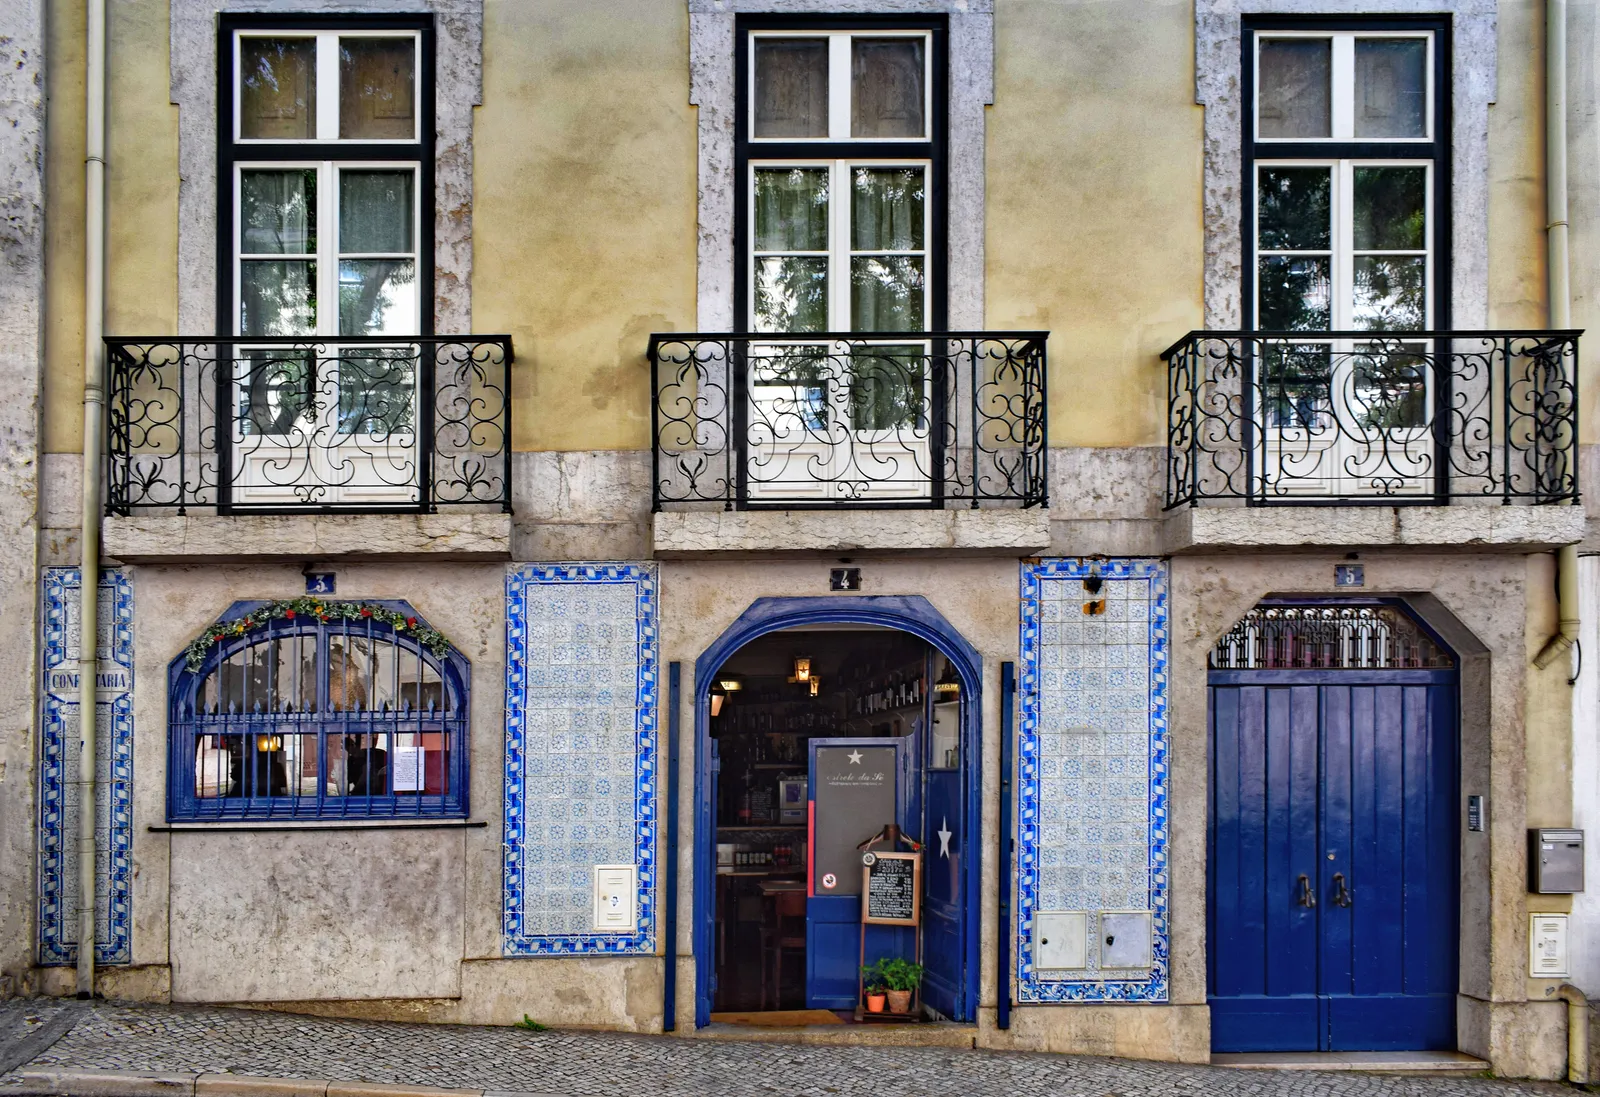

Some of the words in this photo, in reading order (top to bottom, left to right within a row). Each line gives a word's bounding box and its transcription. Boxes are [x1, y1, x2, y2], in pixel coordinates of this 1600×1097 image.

[315, 574, 326, 593] 3
[840, 570, 850, 590] 4
[1346, 567, 1355, 584] 5
[52, 673, 126, 688] CONFTARIA
